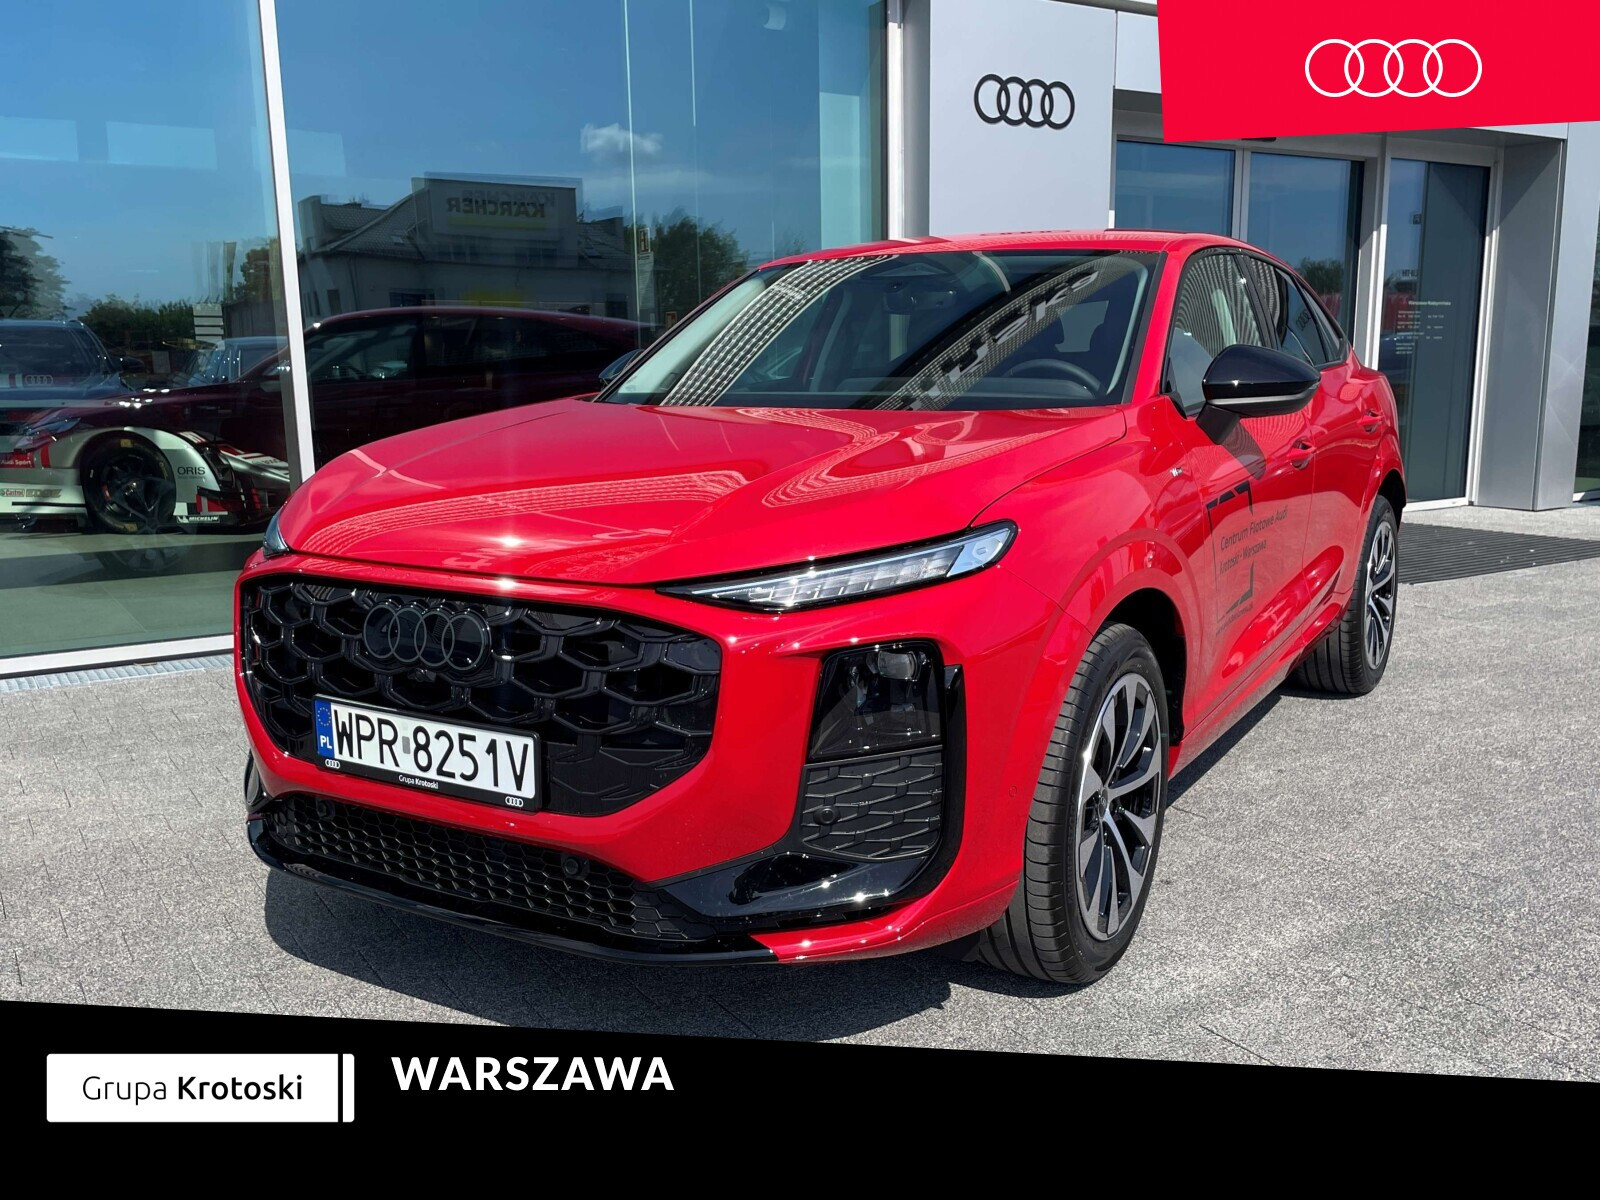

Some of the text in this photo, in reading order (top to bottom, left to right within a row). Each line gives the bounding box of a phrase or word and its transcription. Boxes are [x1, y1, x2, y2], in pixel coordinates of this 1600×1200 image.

[177, 466, 206, 476] ORIS
[1221, 506, 1288, 551] Centrum Flotowe Audi
[320, 735, 333, 750] PL
[333, 709, 529, 792] WPR 8251V
[398, 775, 439, 789] Grupa Krotoski
